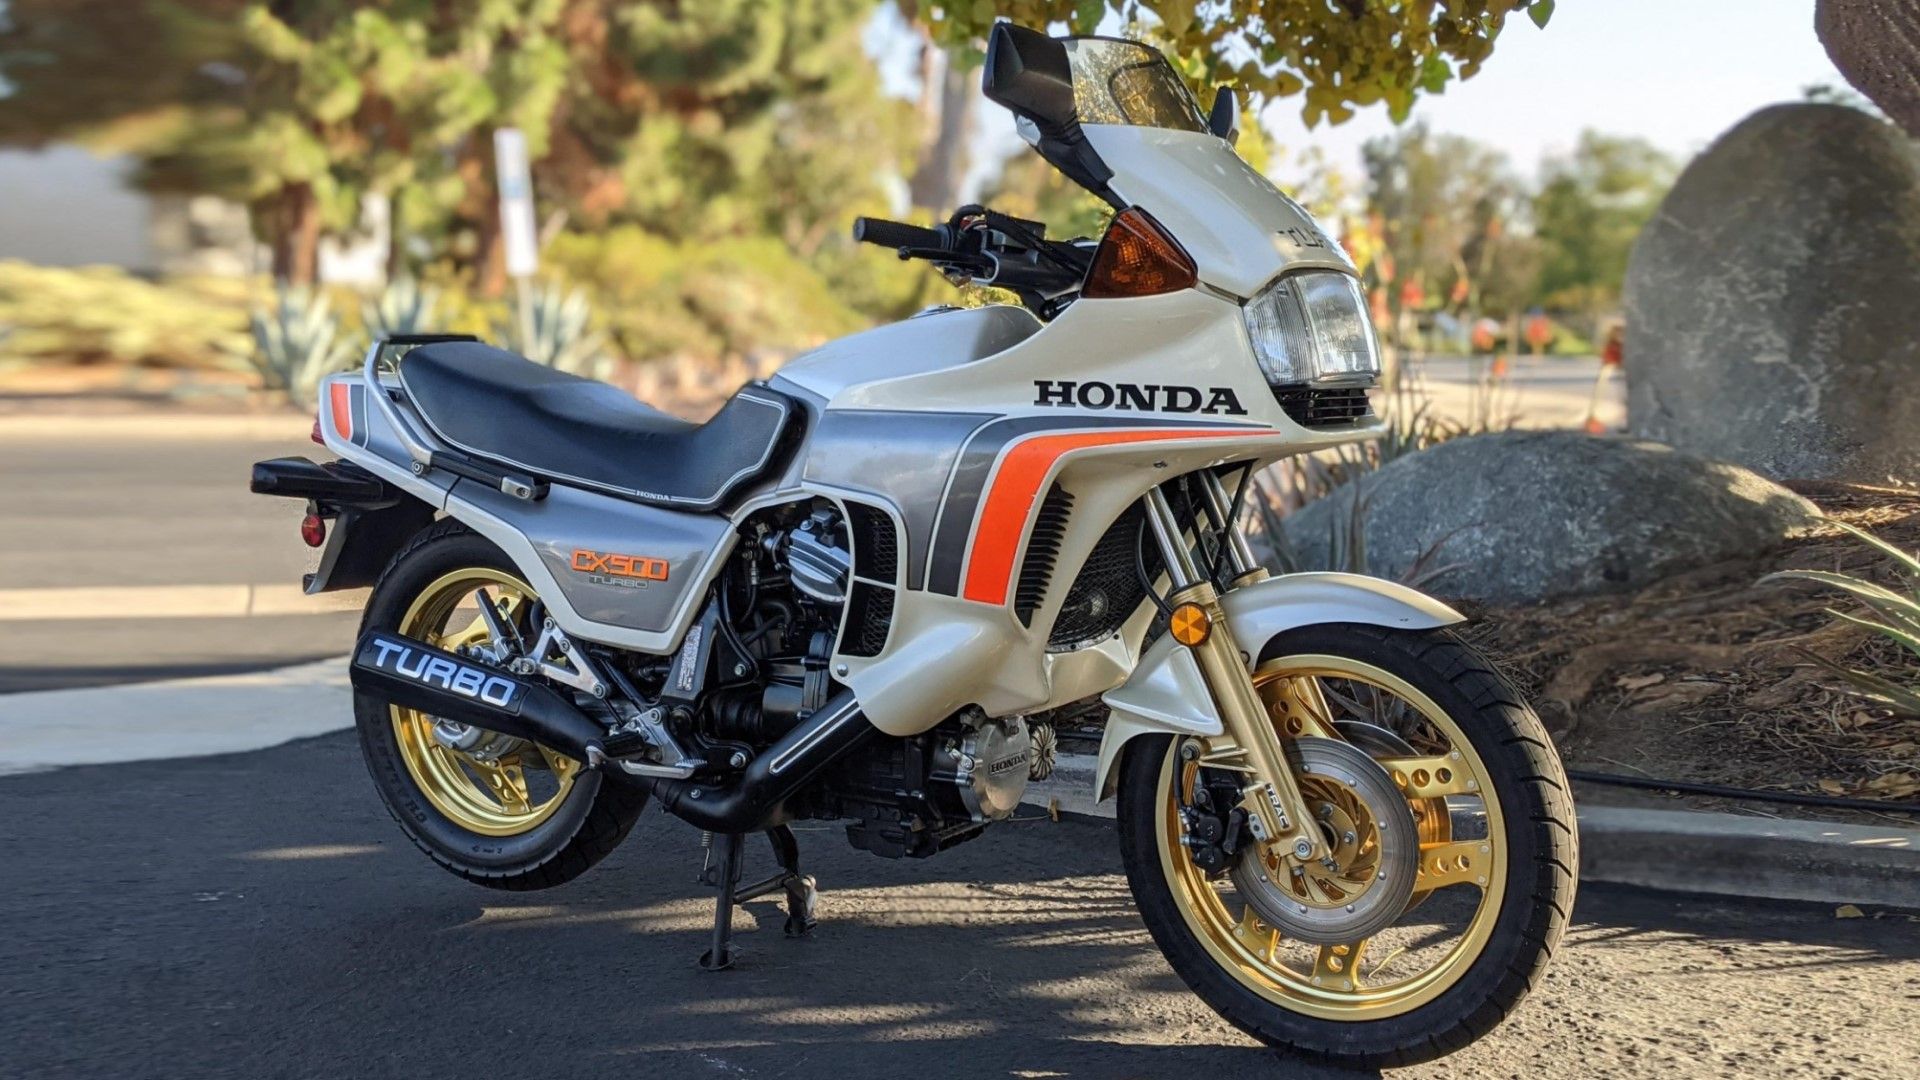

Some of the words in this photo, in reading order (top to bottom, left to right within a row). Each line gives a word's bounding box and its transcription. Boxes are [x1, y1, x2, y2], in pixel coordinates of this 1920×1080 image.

[1034, 380, 1248, 416] HONDA
[636, 490, 671, 501] HONDA
[571, 549, 670, 581] CX500
[588, 575, 649, 589] TURBO
[373, 638, 516, 707] TURBO
[990, 752, 1027, 774] HONDA
[1265, 784, 1289, 827] TRAC
